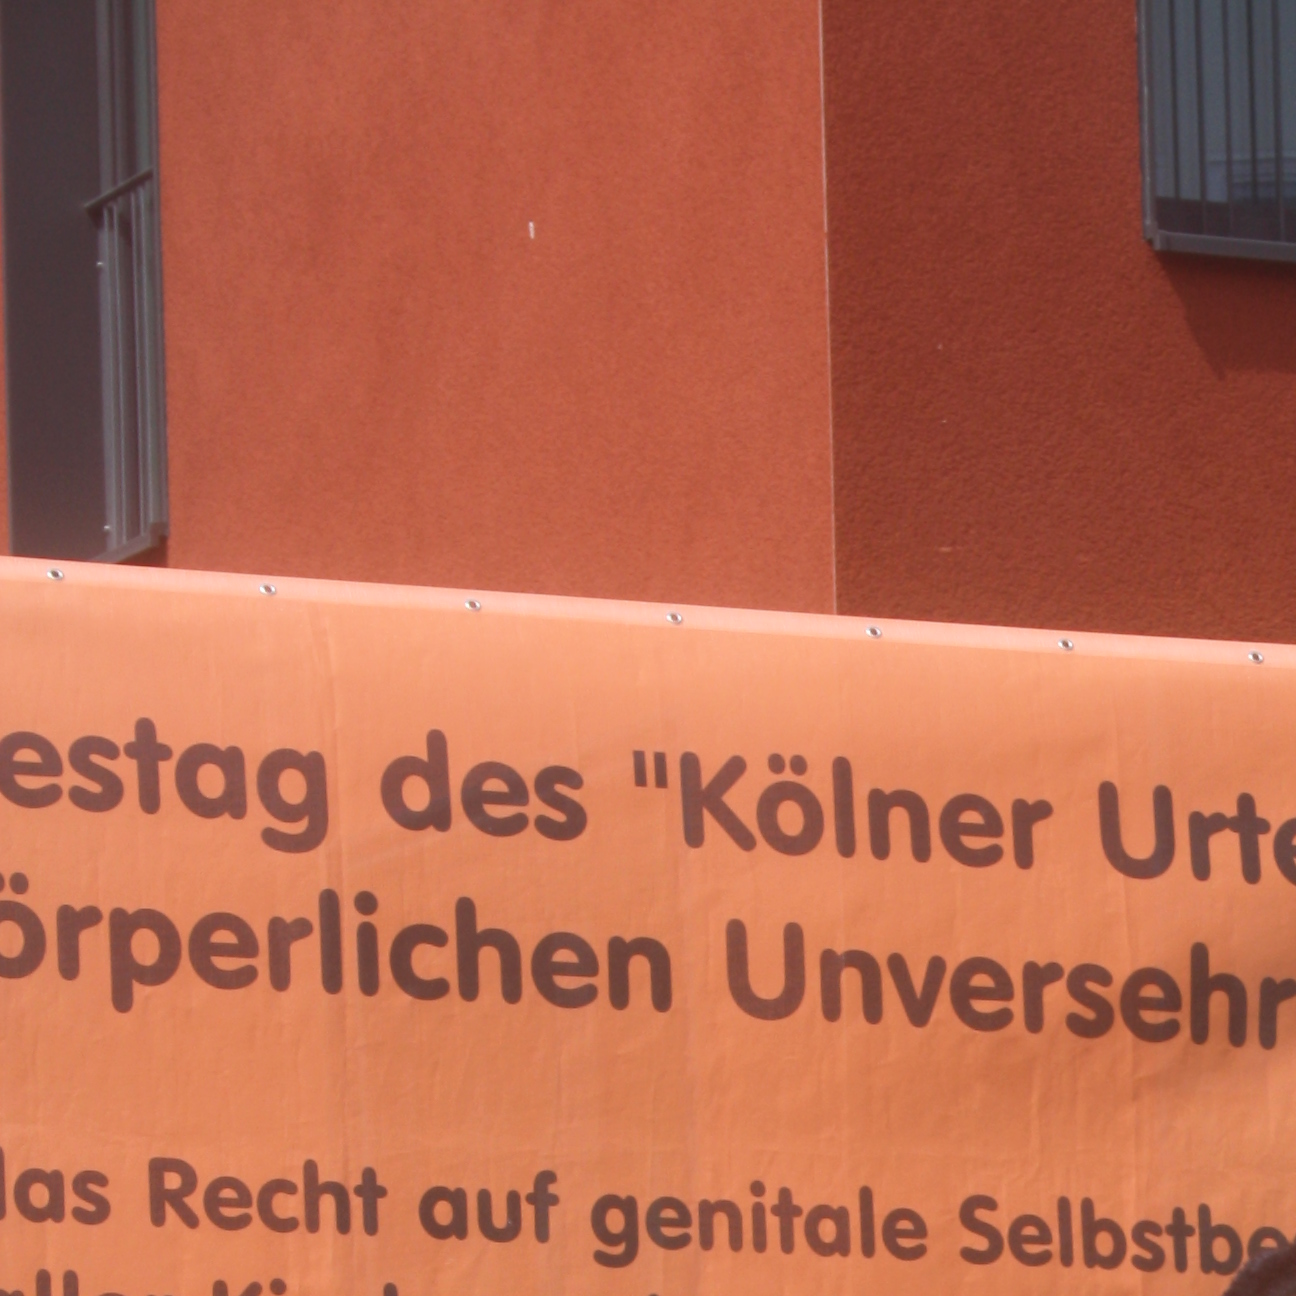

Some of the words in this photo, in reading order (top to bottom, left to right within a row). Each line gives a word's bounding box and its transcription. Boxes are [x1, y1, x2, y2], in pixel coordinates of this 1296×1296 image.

[0, 721, 329, 853] estag
[380, 728, 588, 842] des
[633, 750, 1054, 870] "Kölner
[0, 871, 674, 1015] örperlichen
[0, 1146, 111, 1226] as
[148, 1157, 388, 1236] Recht
[418, 1169, 560, 1244] auf
[591, 1180, 929, 1268] genitale
